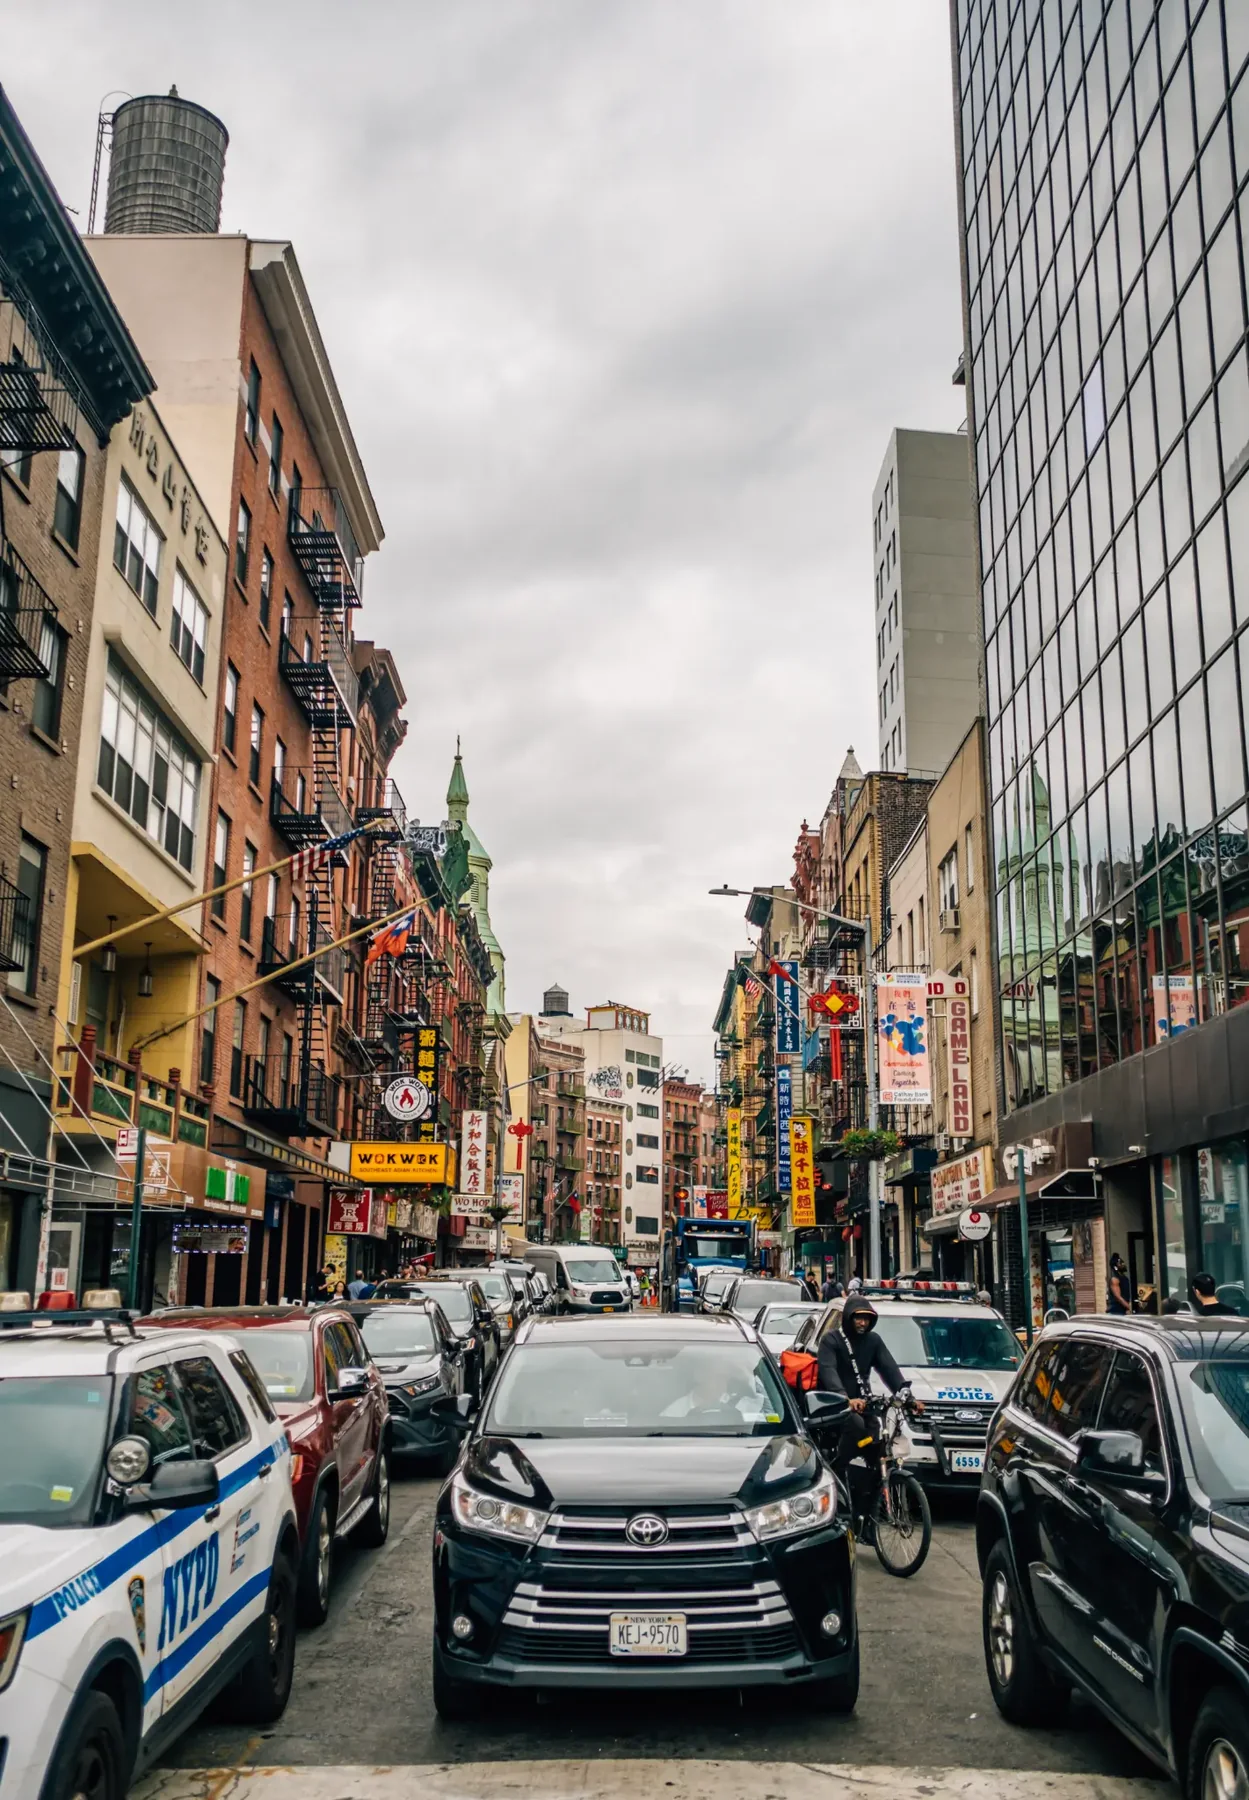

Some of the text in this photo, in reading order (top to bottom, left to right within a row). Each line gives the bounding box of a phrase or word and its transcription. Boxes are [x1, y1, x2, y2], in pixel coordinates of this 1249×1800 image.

[389, 1078, 425, 1092] WOK WOK
[358, 1153, 439, 1165] WOK WOK
[454, 1197, 470, 1206] WO
[937, 1391, 994, 1401] POLICE
[955, 1456, 980, 1468] 4559
[52, 1567, 102, 1620] POLICE
[157, 1530, 219, 1652] NYPD
[630, 1616, 668, 1624] NEW YORK
